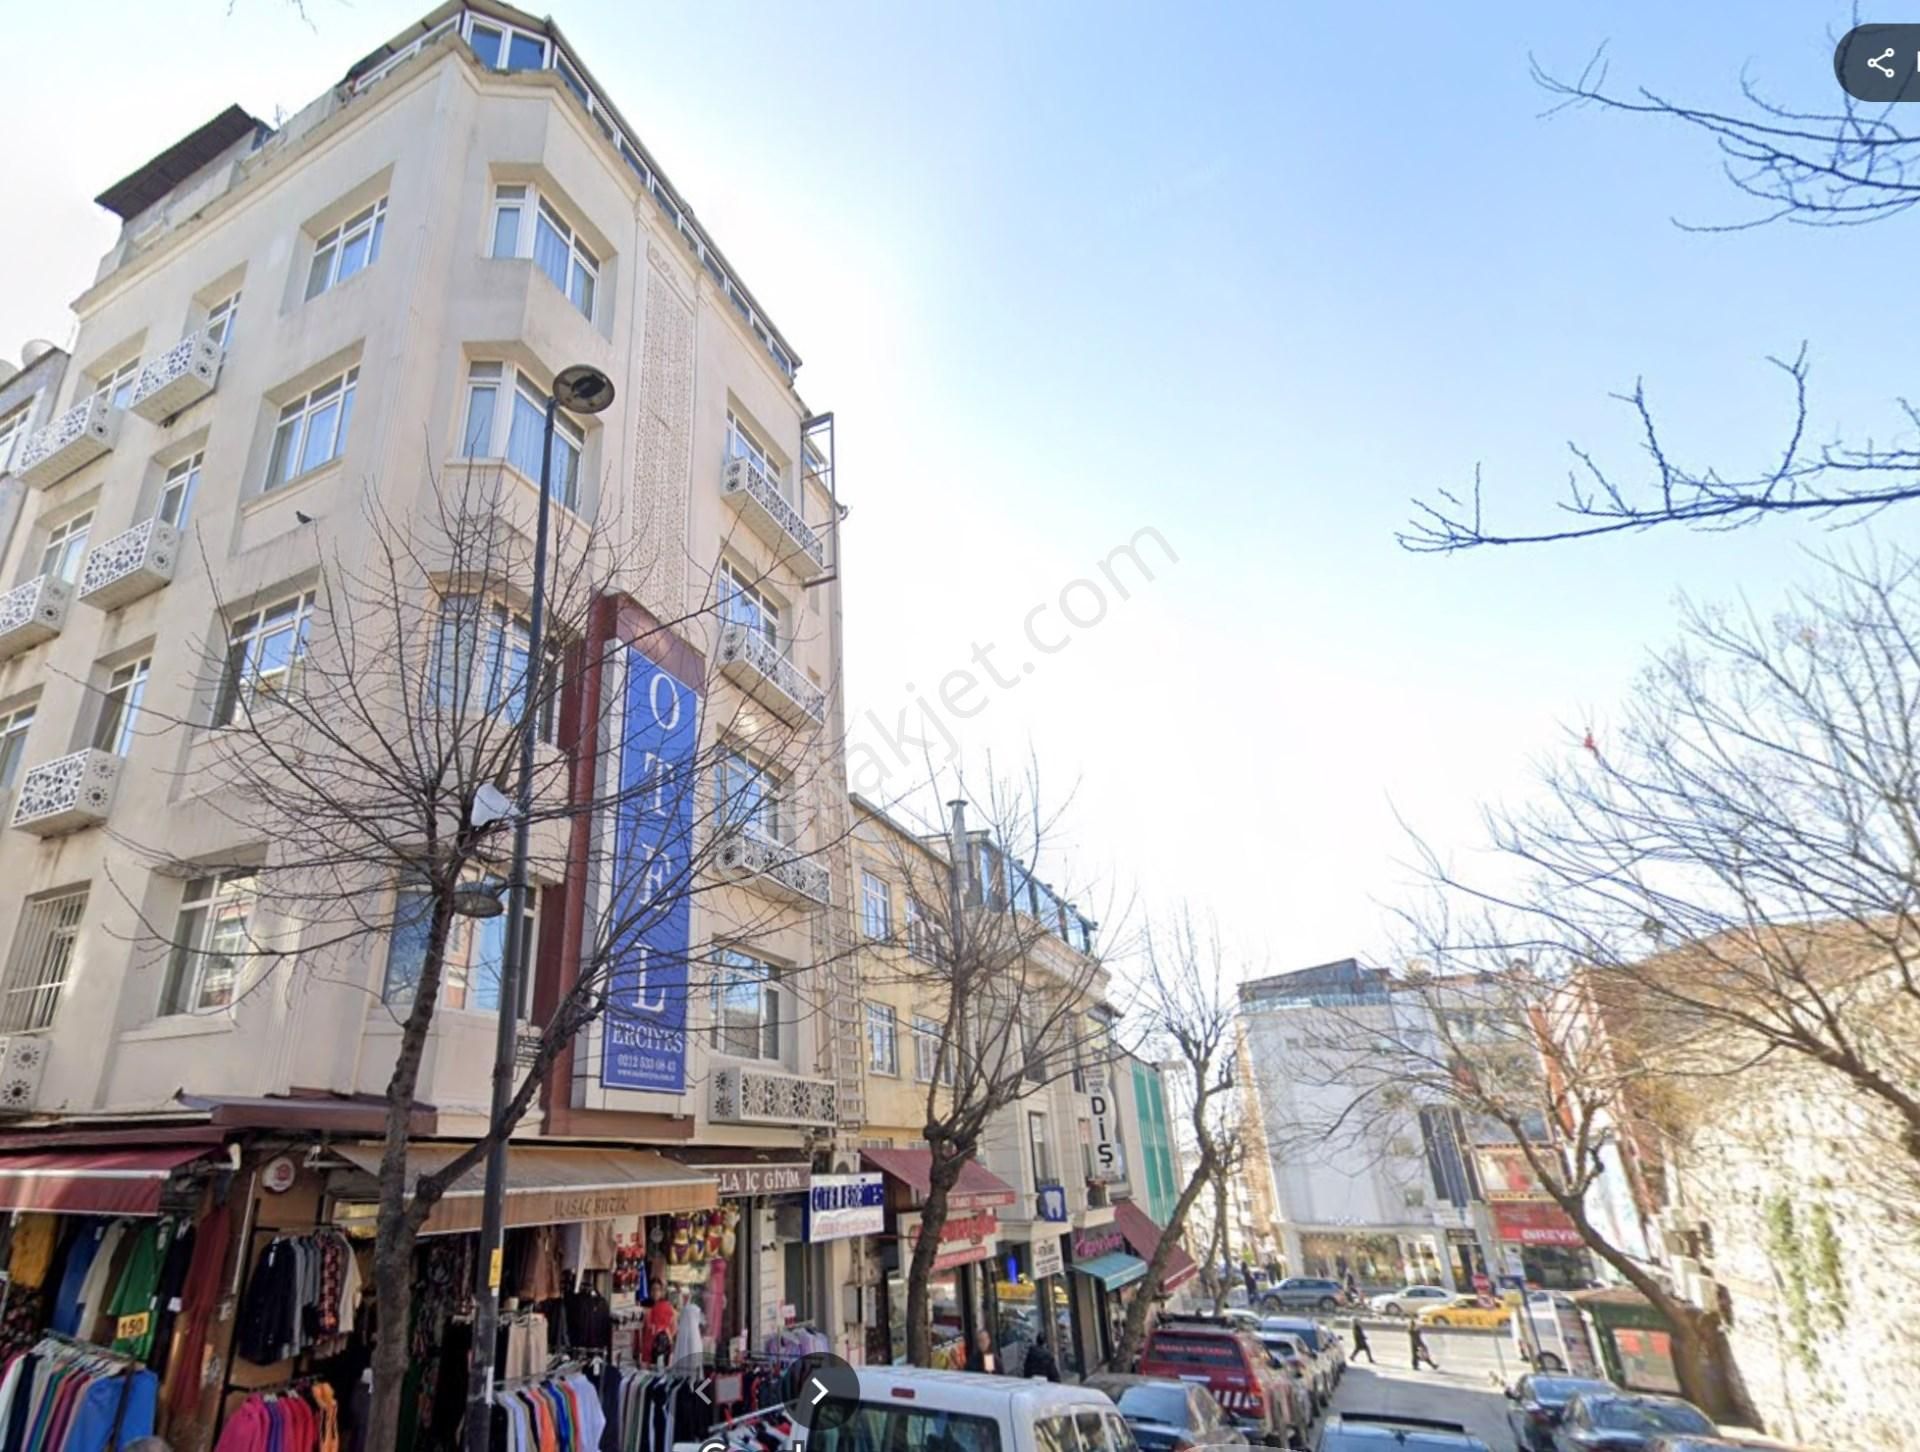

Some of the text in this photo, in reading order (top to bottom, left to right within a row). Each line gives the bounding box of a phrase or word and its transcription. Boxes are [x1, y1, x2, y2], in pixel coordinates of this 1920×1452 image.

[631, 672, 680, 1013] OTEL
[764, 1169, 800, 1191] GİYİM
[121, 1317, 145, 1337] 150
